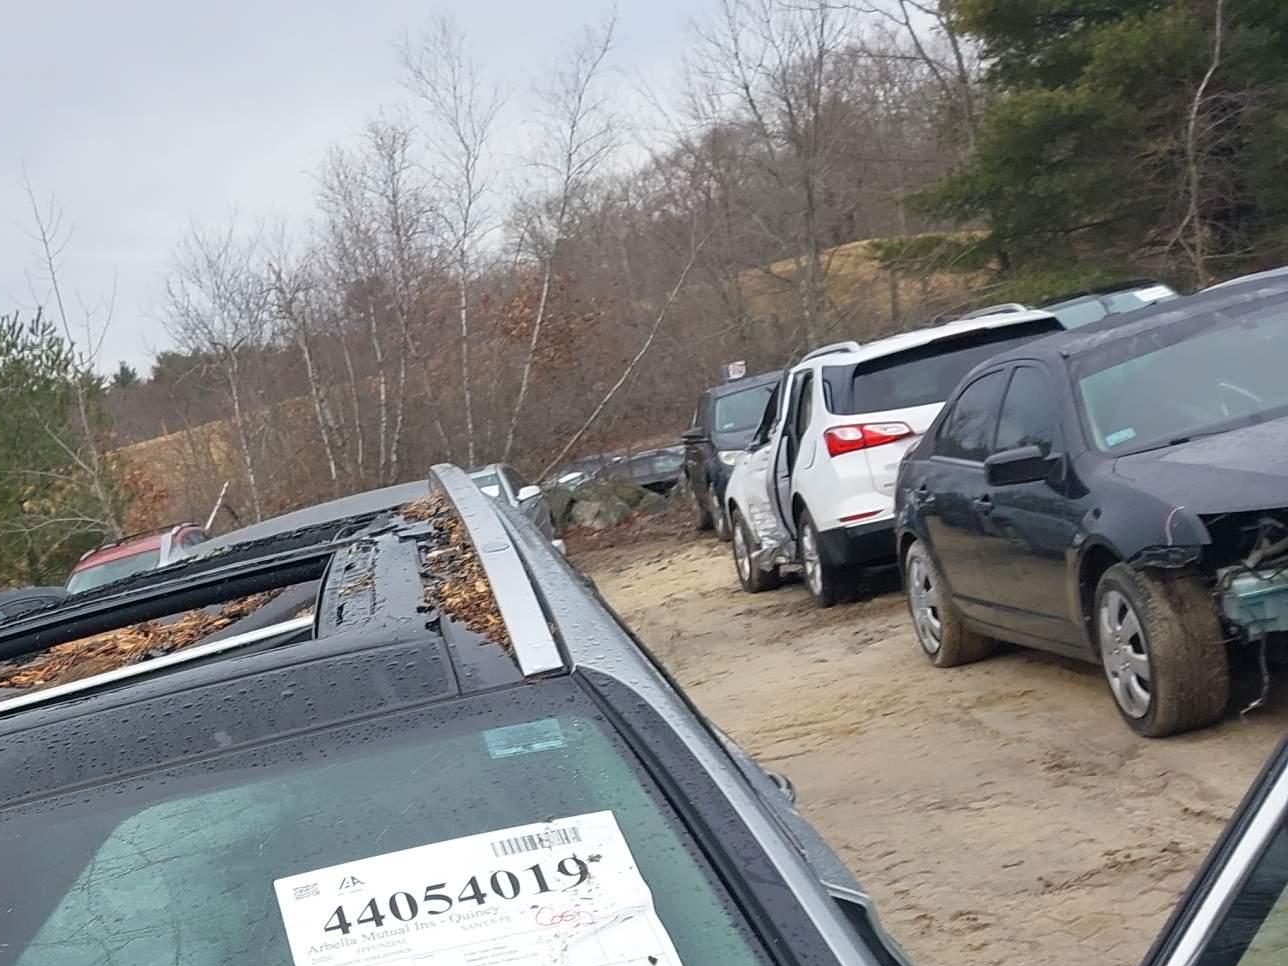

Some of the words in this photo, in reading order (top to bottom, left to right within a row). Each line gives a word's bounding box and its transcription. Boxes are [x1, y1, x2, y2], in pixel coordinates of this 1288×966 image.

[306, 937, 358, 956] Arbella
[360, 923, 411, 943] Mutual
[414, 916, 437, 932] Ins
[448, 905, 500, 925] Quincy
